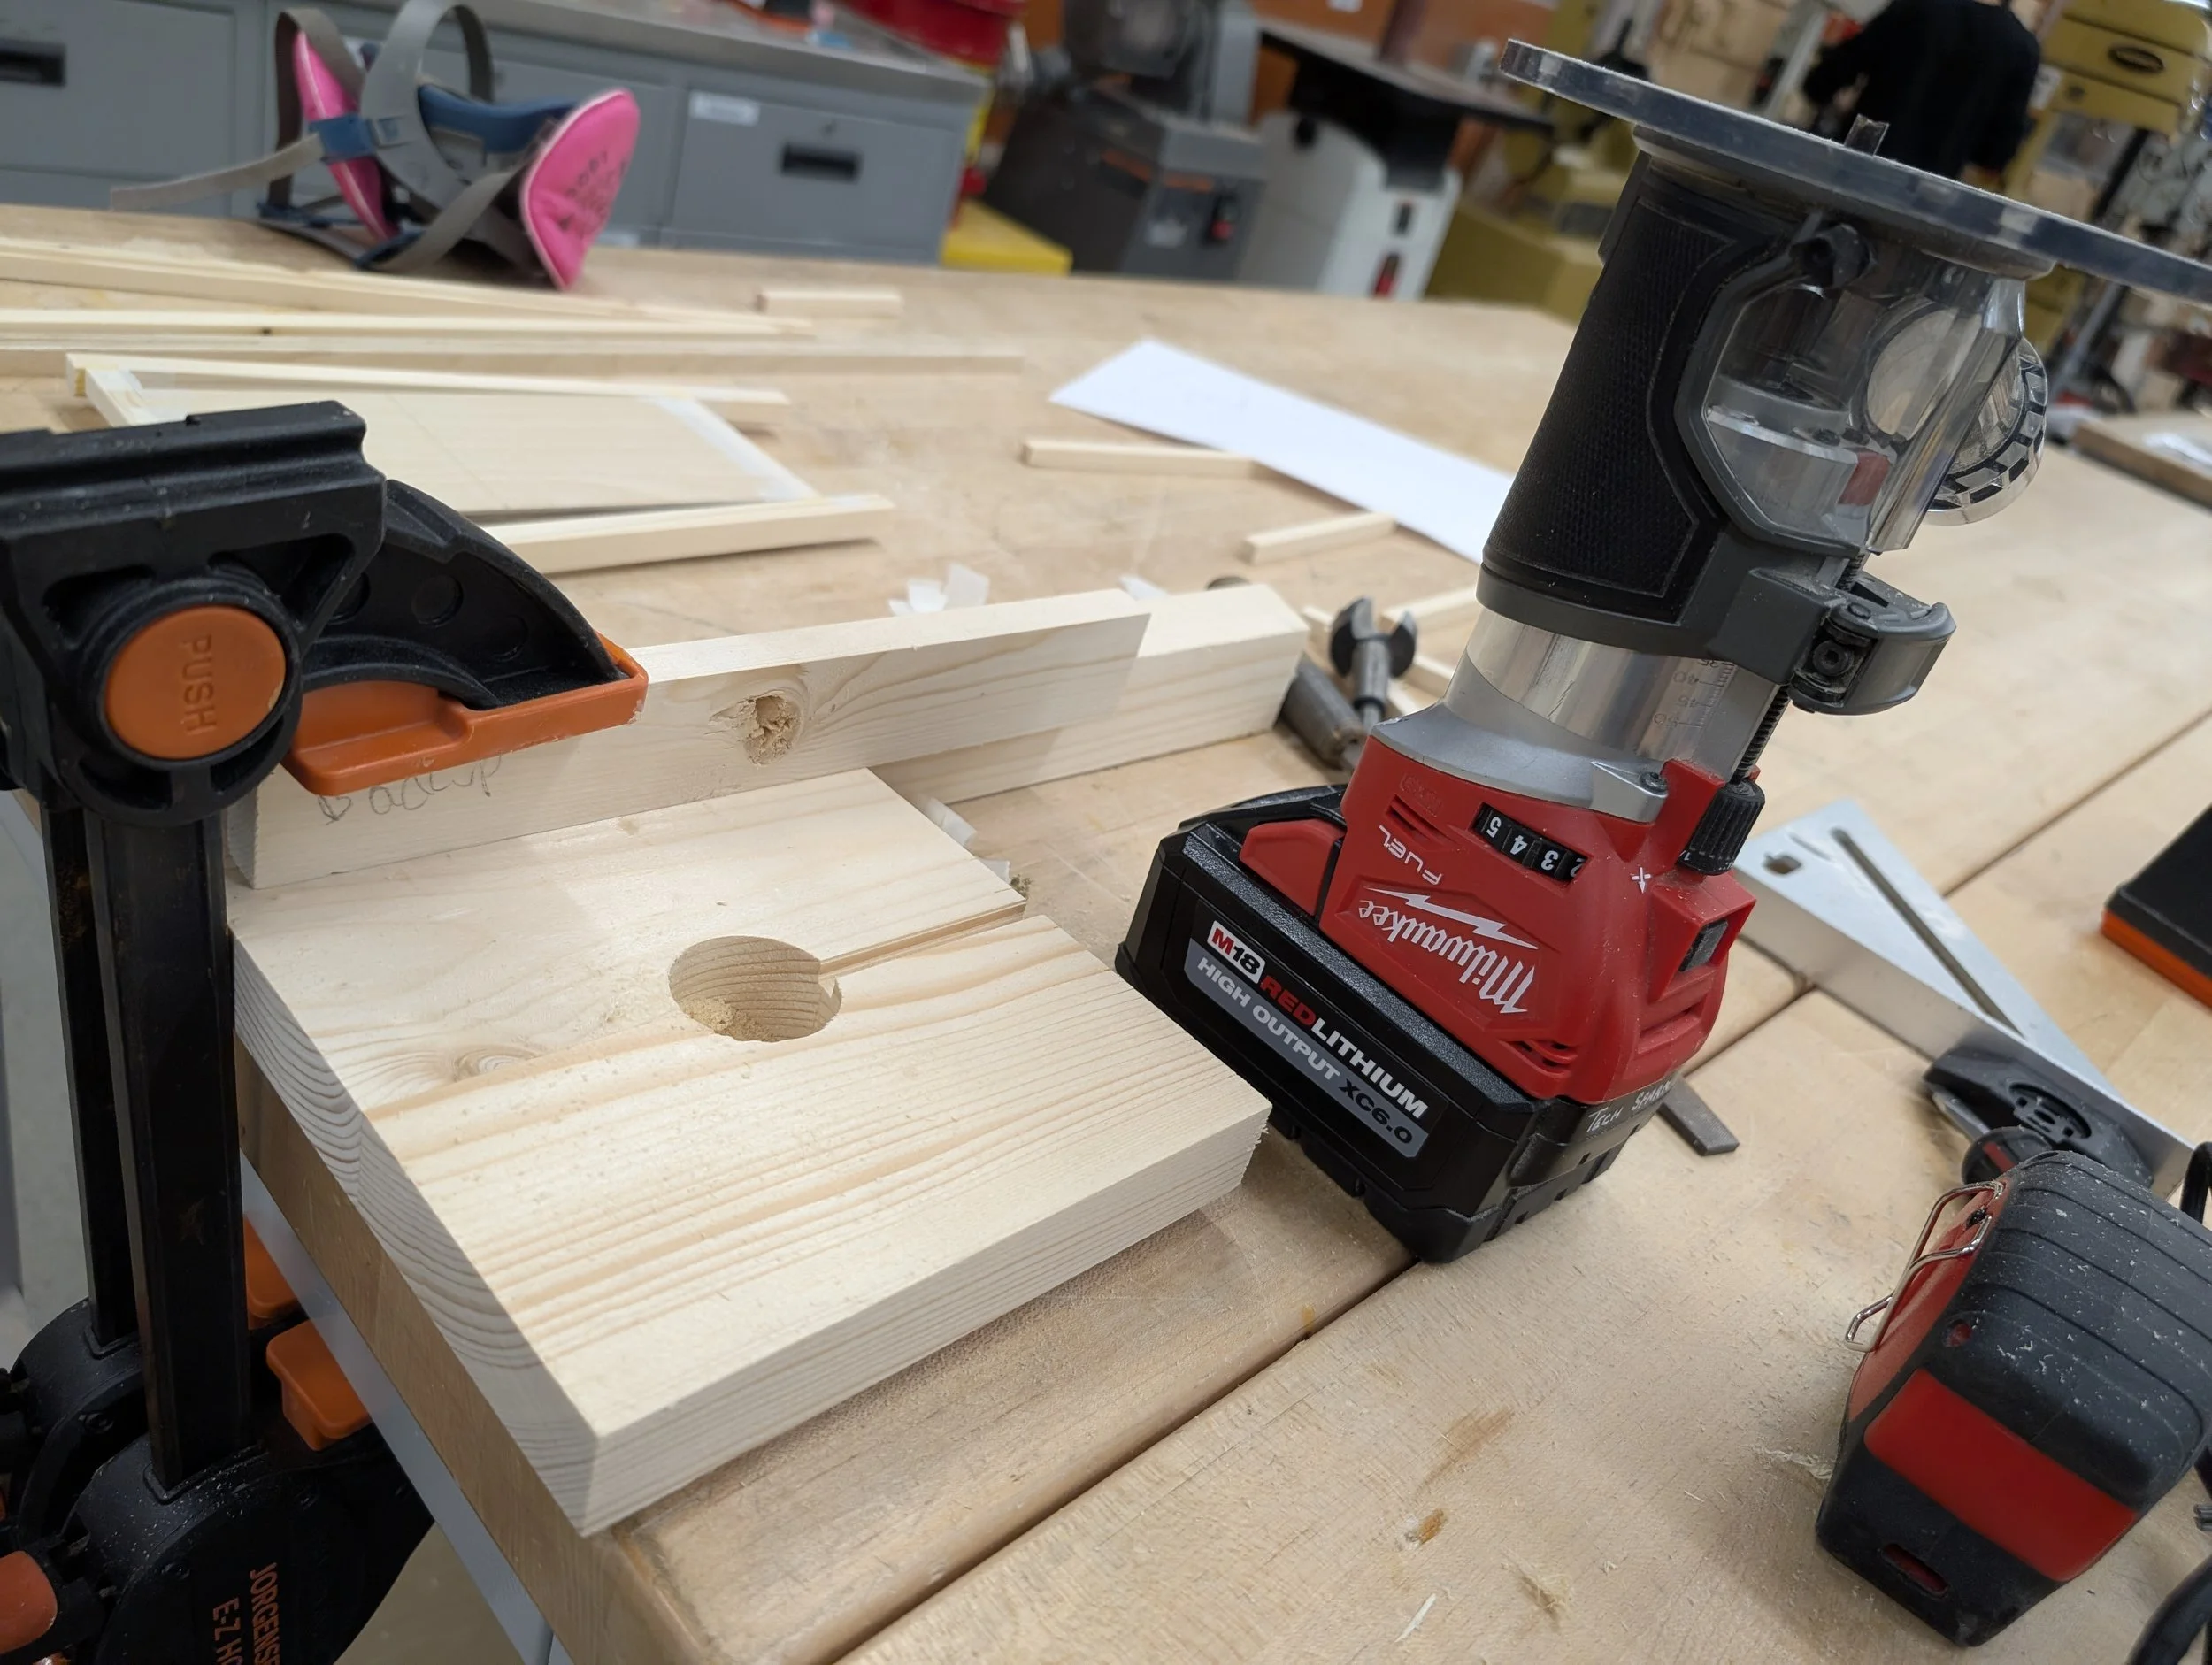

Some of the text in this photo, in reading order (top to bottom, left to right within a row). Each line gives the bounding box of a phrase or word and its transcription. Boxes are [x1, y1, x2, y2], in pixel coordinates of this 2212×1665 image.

[181, 634, 217, 733] PUSH
[1379, 824, 1443, 885] FUEL
[1486, 816, 1502, 838] 5
[1509, 834, 1528, 855] 4
[1540, 850, 1559, 871] 3
[1358, 900, 1535, 1014] Milwaukee
[1197, 957, 1414, 1145] HIGH OUTPUT XC6.0
[1211, 927, 1428, 1119] M18 REDLITHIUM
[212, 1596, 242, 1642] E-Z
